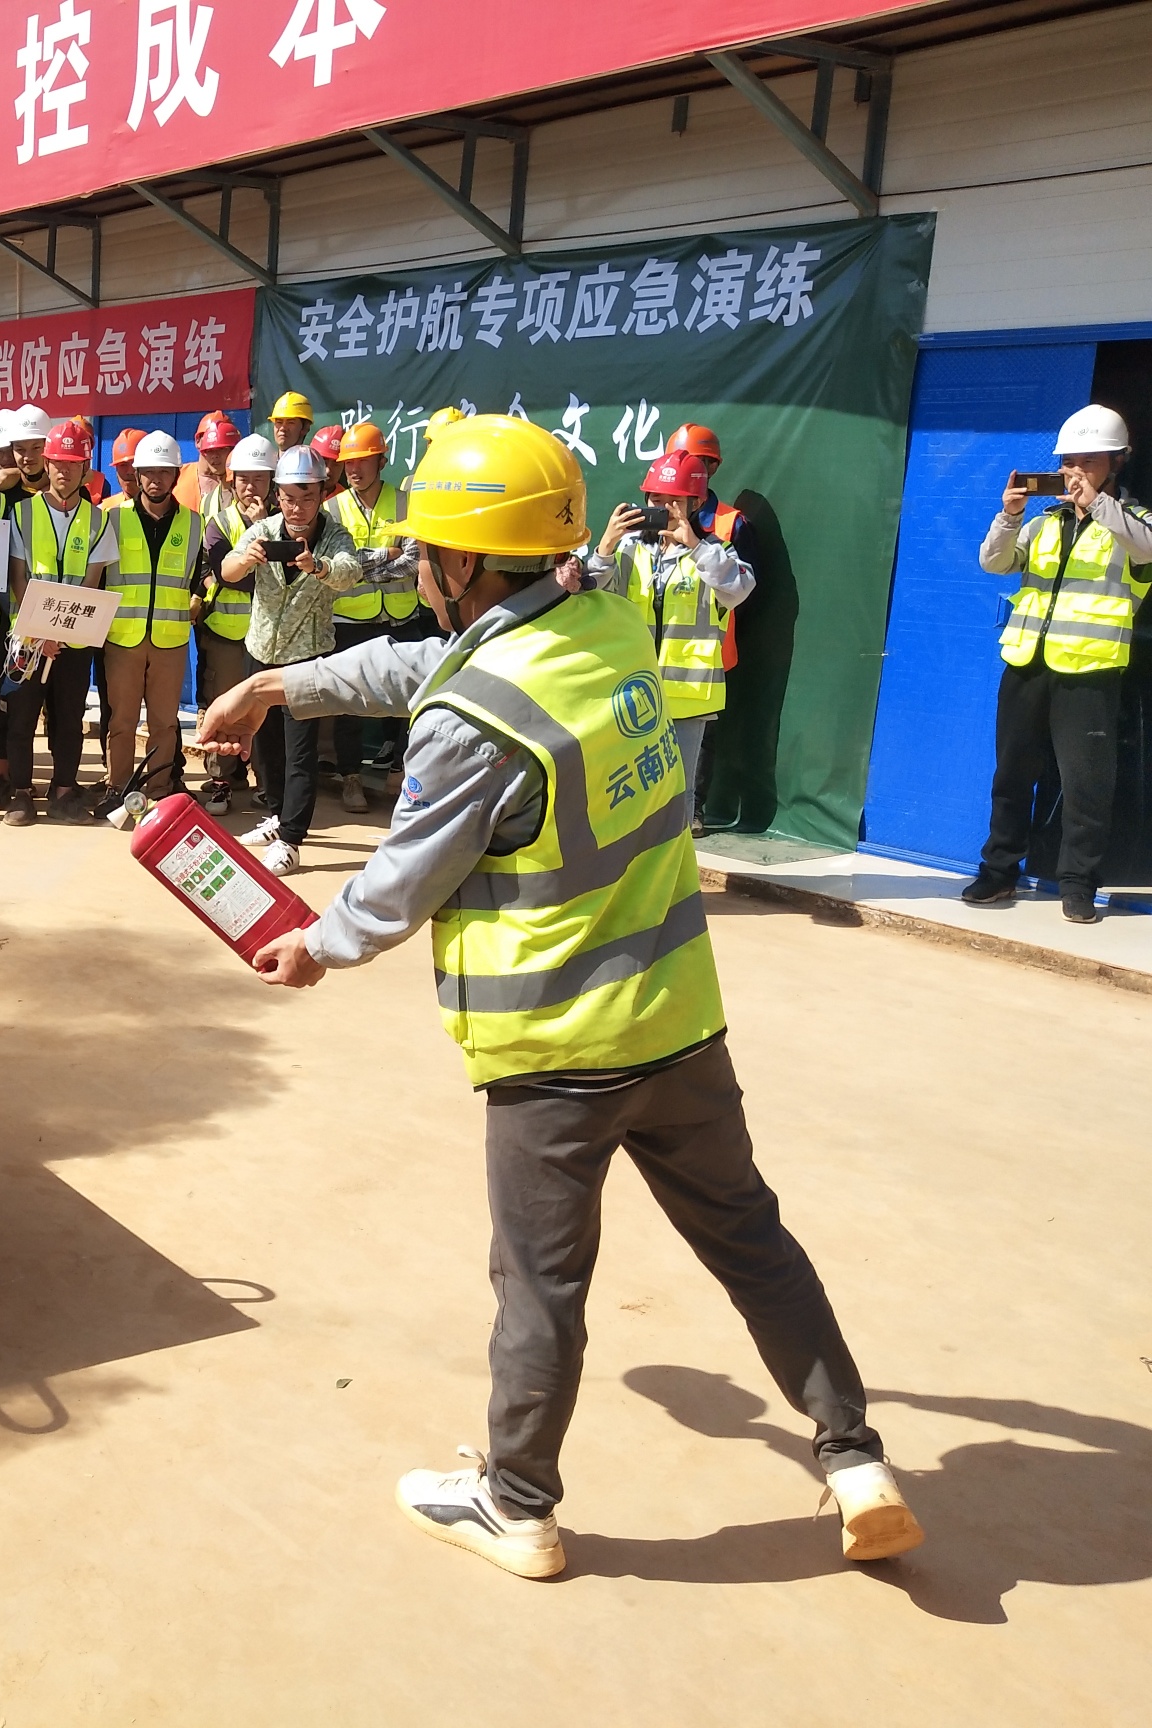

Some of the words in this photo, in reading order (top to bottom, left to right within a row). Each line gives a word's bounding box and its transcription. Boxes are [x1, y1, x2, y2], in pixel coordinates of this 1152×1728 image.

[297, 241, 822, 363] 安全护航专项应急演练
[42, 596, 97, 619] 善后处理
[49, 613, 77, 630] 小组
